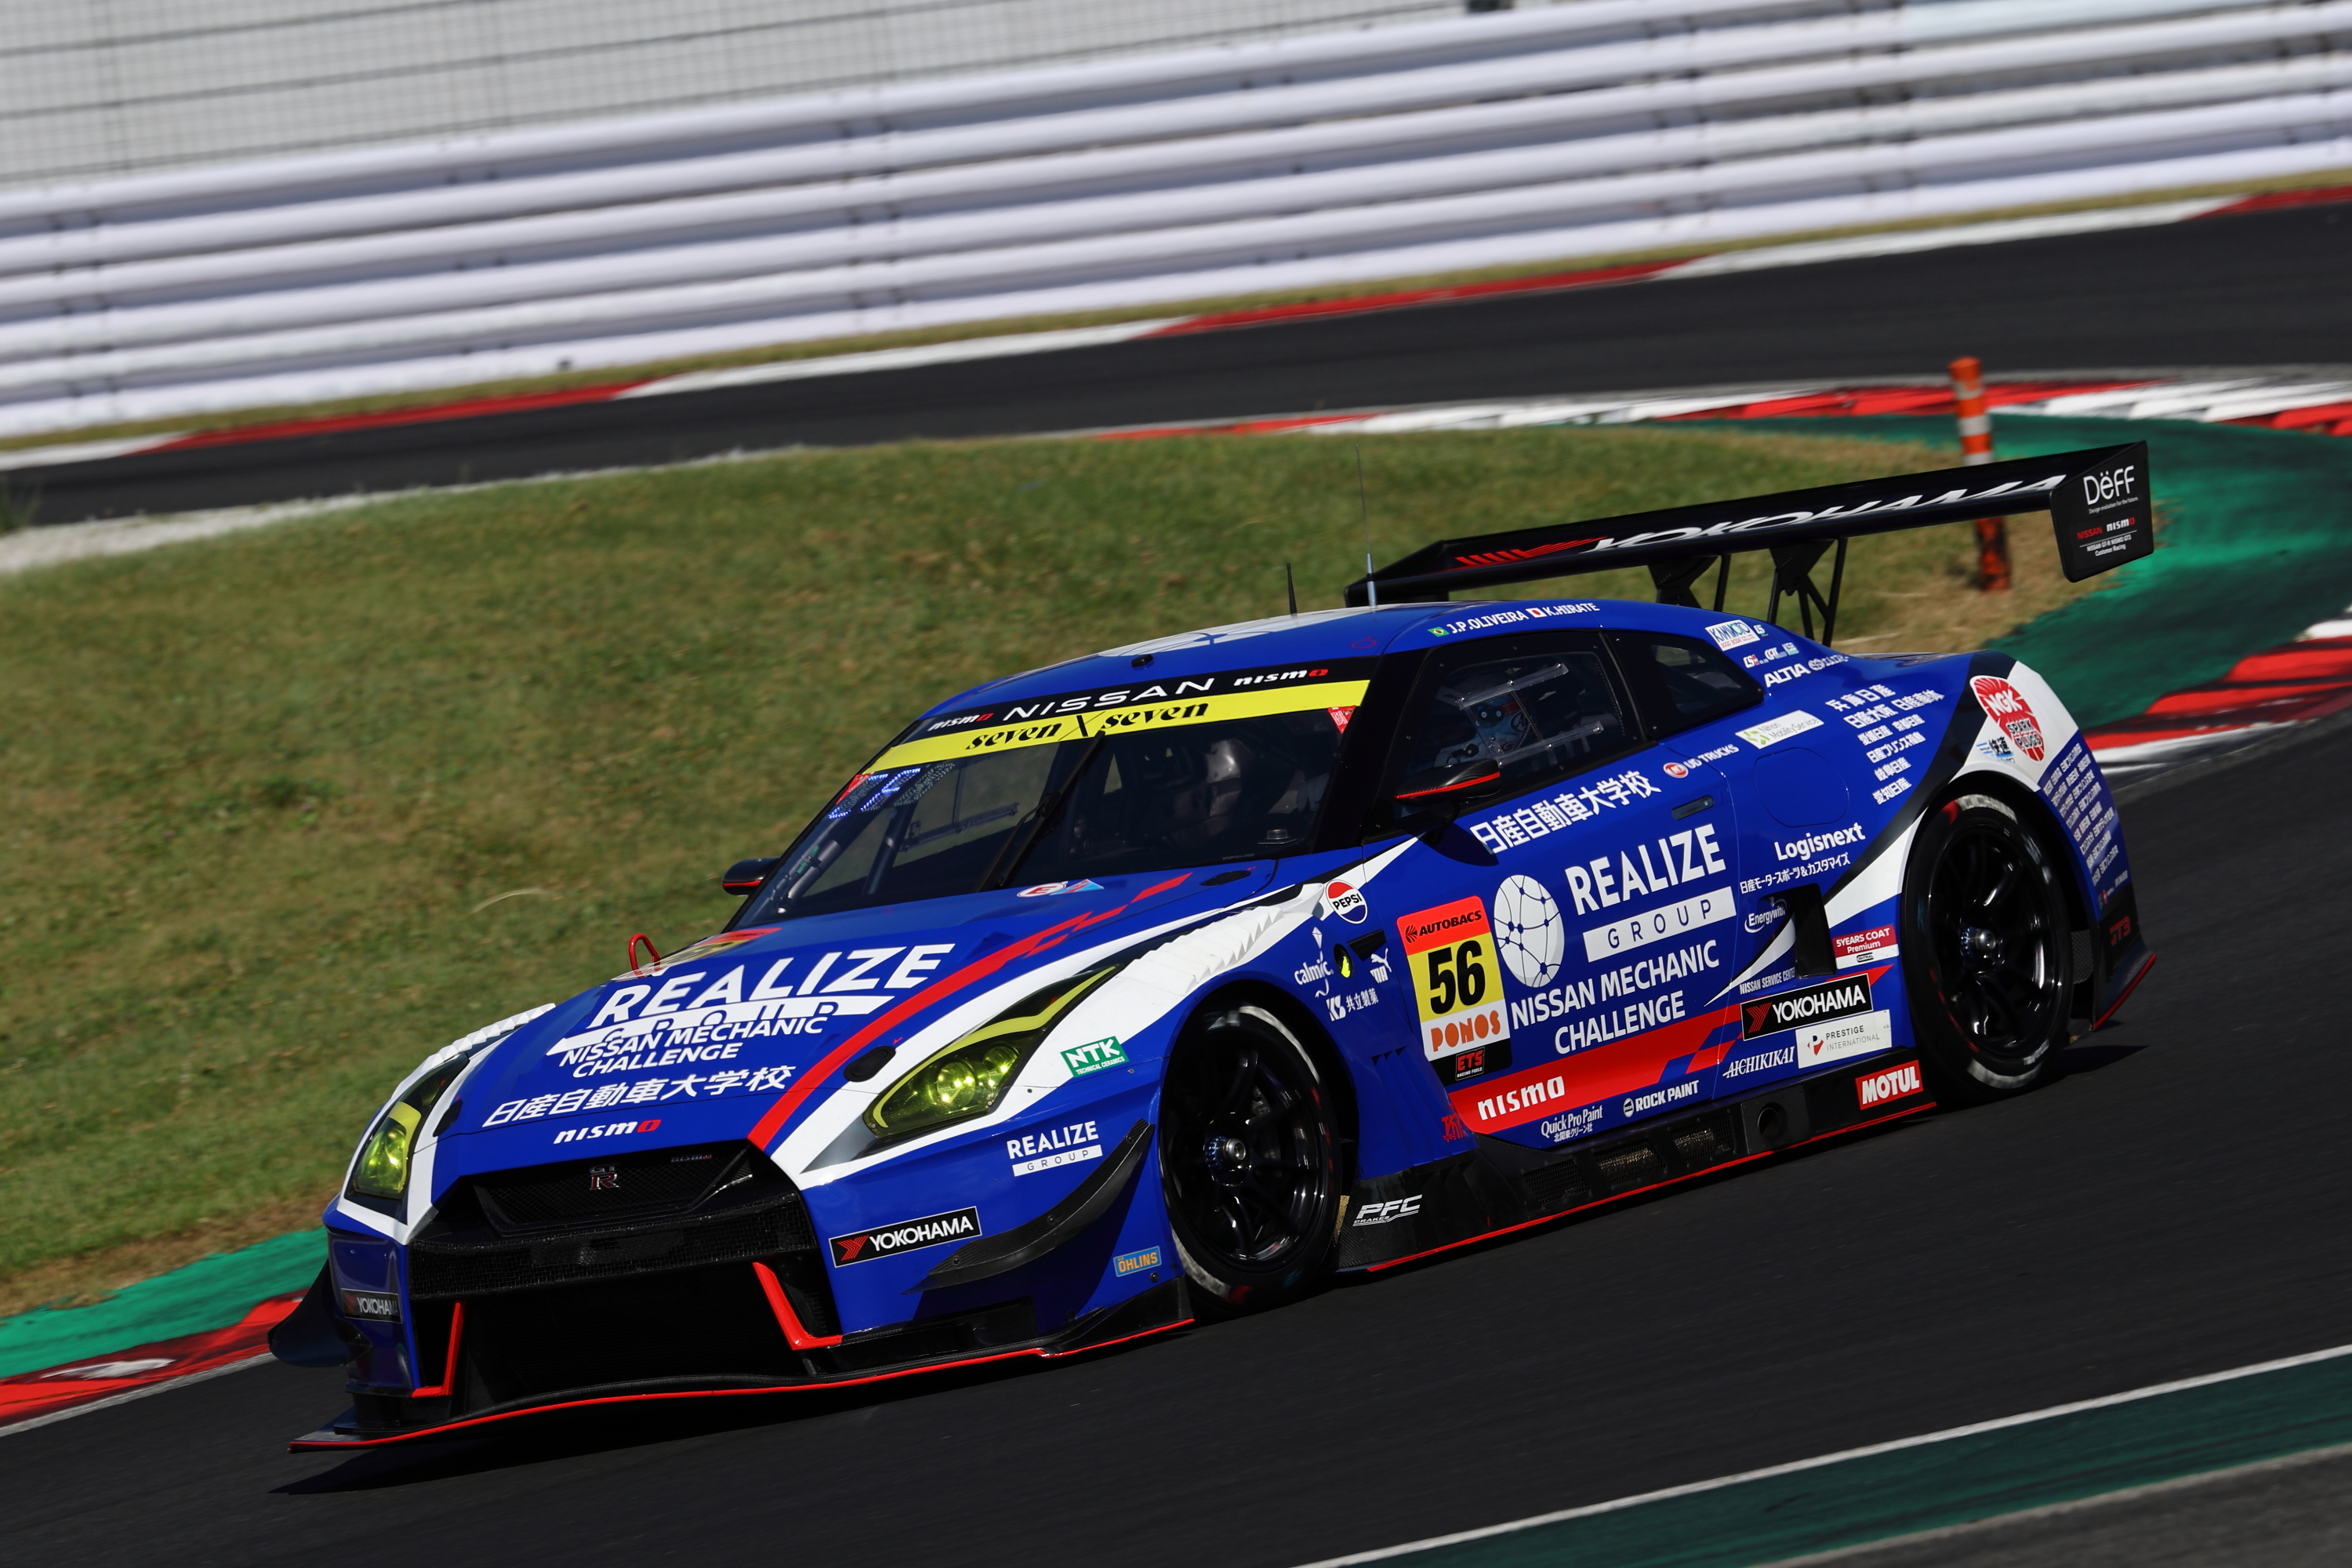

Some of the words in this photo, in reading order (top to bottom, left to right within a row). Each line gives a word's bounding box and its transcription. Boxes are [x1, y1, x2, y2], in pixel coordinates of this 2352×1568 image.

[1579, 474, 2067, 554] YOKOHAMA
[2076, 526, 2103, 540] NISSAN
[2095, 547, 2113, 557] Customer
[2112, 543, 2126, 552] Racing
[1446, 609, 1530, 634] J.P.OLIVEIRA
[1542, 602, 1601, 616] K.HIRATE
[1233, 668, 1329, 687] nismo
[1764, 663, 1811, 688] ALTIA
[1003, 677, 1215, 721] NISSAN
[1983, 689, 2024, 717] NGK
[927, 713, 993, 732] nismo
[965, 722, 1063, 750] seven
[1102, 702, 1210, 731] seven
[1843, 703, 1899, 729] 日産大阪
[2007, 719, 2035, 735] SPARK
[2015, 733, 2042, 748] PLUGS
[1682, 757, 1703, 769] UD
[1697, 743, 1740, 763] TRUCKS
[1872, 777, 1912, 805] 愛知日産
[1469, 769, 1662, 855] 日産自動車大学校
[1774, 822, 1866, 861] Logisnext
[1564, 823, 1726, 916] REALIZE
[1740, 852, 1851, 895] 日産モータースポーツ&カスタマイズ
[1333, 894, 1363, 910] PEPSI
[1748, 904, 1786, 927] Energywith
[1419, 909, 1483, 937] AUTOBACS
[1608, 898, 1712, 949] GROUP
[1836, 934, 1865, 948] 5YEARS
[1866, 927, 1890, 941] COAT
[1847, 941, 1881, 954] Premium
[586, 943, 956, 1029] REALIZE
[1294, 961, 1332, 985] calmic
[1428, 940, 1486, 1015] 56
[1510, 982, 1597, 1030] NISSAN
[1599, 940, 1719, 1001] MECHANIC
[1740, 979, 1761, 995] NISSAN
[1761, 972, 1782, 989] SERVICE
[1772, 985, 1867, 1024] YOKOHAMA
[1431, 1011, 1501, 1052] PONOS
[1555, 990, 1686, 1054] CHALLENGE
[1826, 1025, 1864, 1040] PRESTIGE
[558, 1031, 665, 1068] NISSAN
[664, 1016, 828, 1049] MECHANIC
[1065, 1039, 1120, 1069] NTK
[1826, 1033, 1881, 1052] INTERNATIONAL
[572, 1042, 743, 1079] CHALLENGE
[1075, 1063, 1102, 1075] TECHNICAL
[1101, 1055, 1125, 1068] CERAMICS
[1457, 1050, 1484, 1072] ETS
[1722, 1046, 1795, 1079] AICHIKIKAI
[481, 1065, 797, 1128] 日産自動車大学校
[1477, 1076, 1566, 1121] nismo
[1635, 1089, 1666, 1112] ROCK
[1667, 1080, 1699, 1104] PAINT
[1862, 1065, 1921, 1105] MOTUL
[554, 1120, 662, 1145] nismo
[1541, 1113, 1568, 1138] Quick
[1567, 1110, 1583, 1129] Pro
[1581, 1105, 1603, 1124] Paint
[1007, 1120, 1098, 1160] REALIZE
[1026, 1149, 1090, 1171] GROUP
[1356, 1194, 1423, 1220] PFC
[869, 1215, 974, 1252] YOKOHAMA
[1116, 1252, 1158, 1273] ÖHLINS
[357, 1297, 400, 1316] YOKOHAMA
